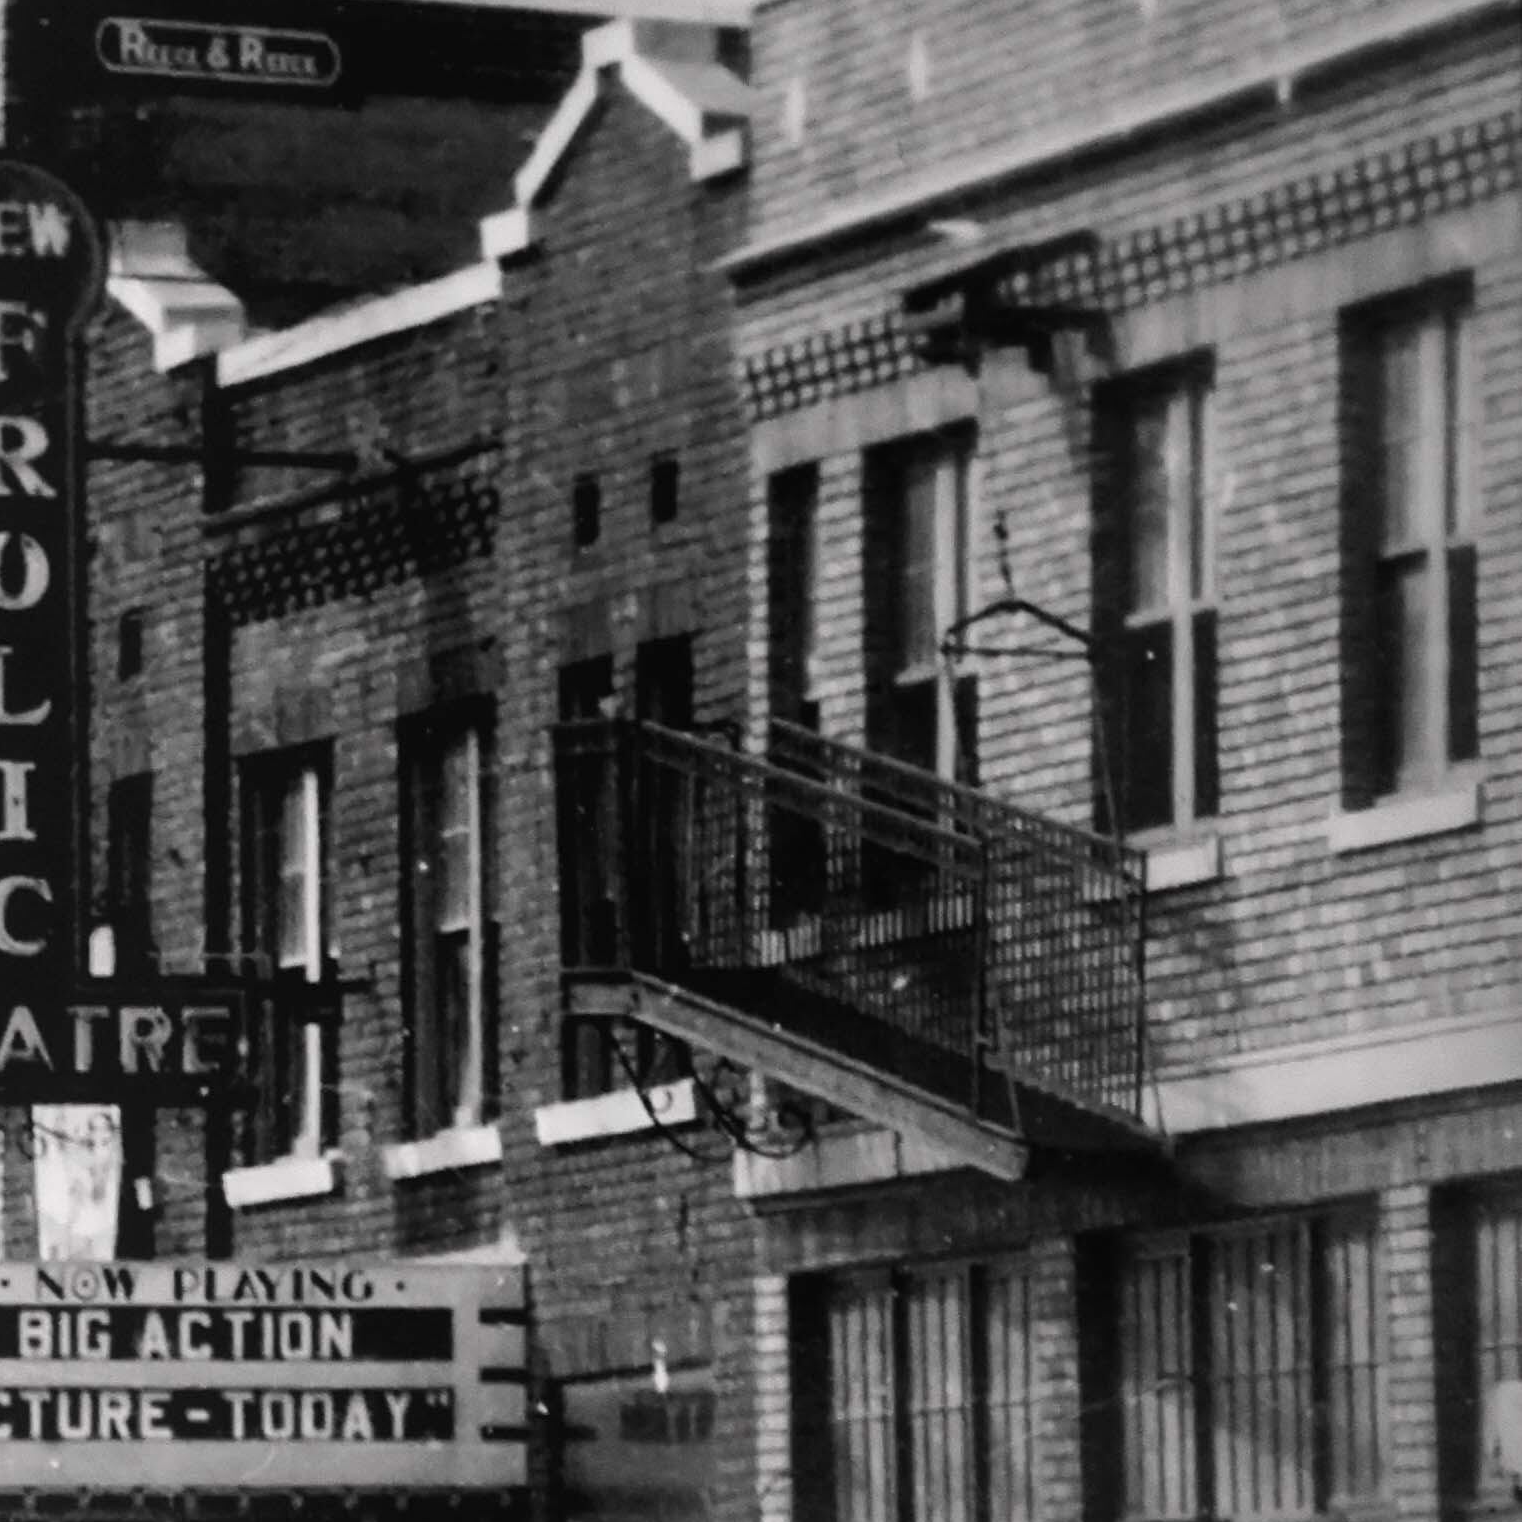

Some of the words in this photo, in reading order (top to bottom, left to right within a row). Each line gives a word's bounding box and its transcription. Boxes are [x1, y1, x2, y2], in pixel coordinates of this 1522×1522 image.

[35, 1267, 137, 1302] NOW
[172, 1267, 375, 1302] PLAYING
[17, 1308, 112, 1359] BIG
[137, 1309, 354, 1360] ACTION
